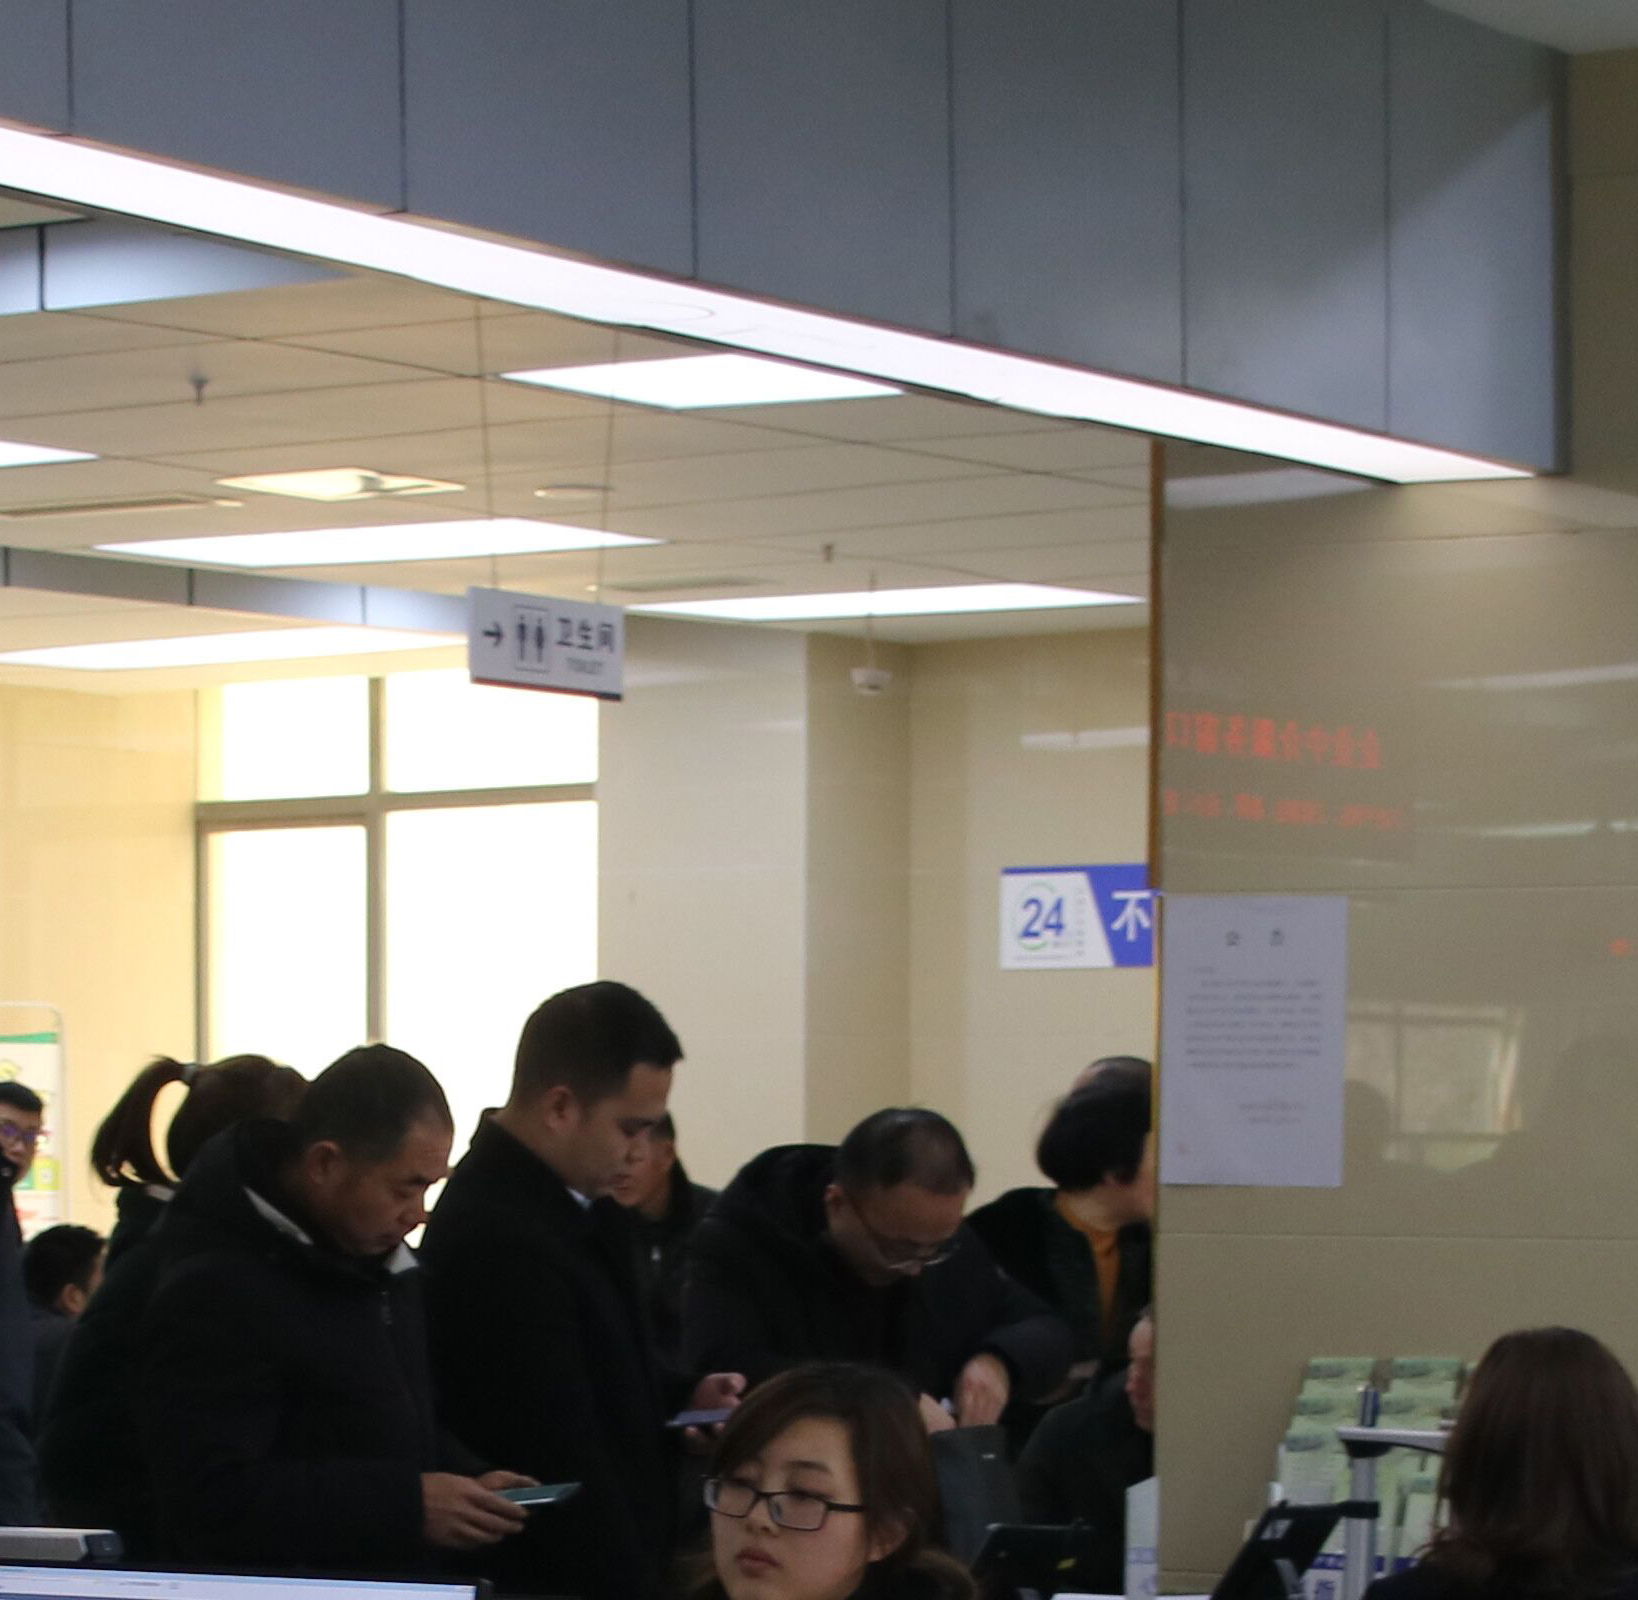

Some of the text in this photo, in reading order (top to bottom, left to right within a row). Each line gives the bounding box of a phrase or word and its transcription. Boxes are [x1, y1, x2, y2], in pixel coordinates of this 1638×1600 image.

[557, 616, 614, 653] 卫生间
[1019, 897, 1066, 938] 24
